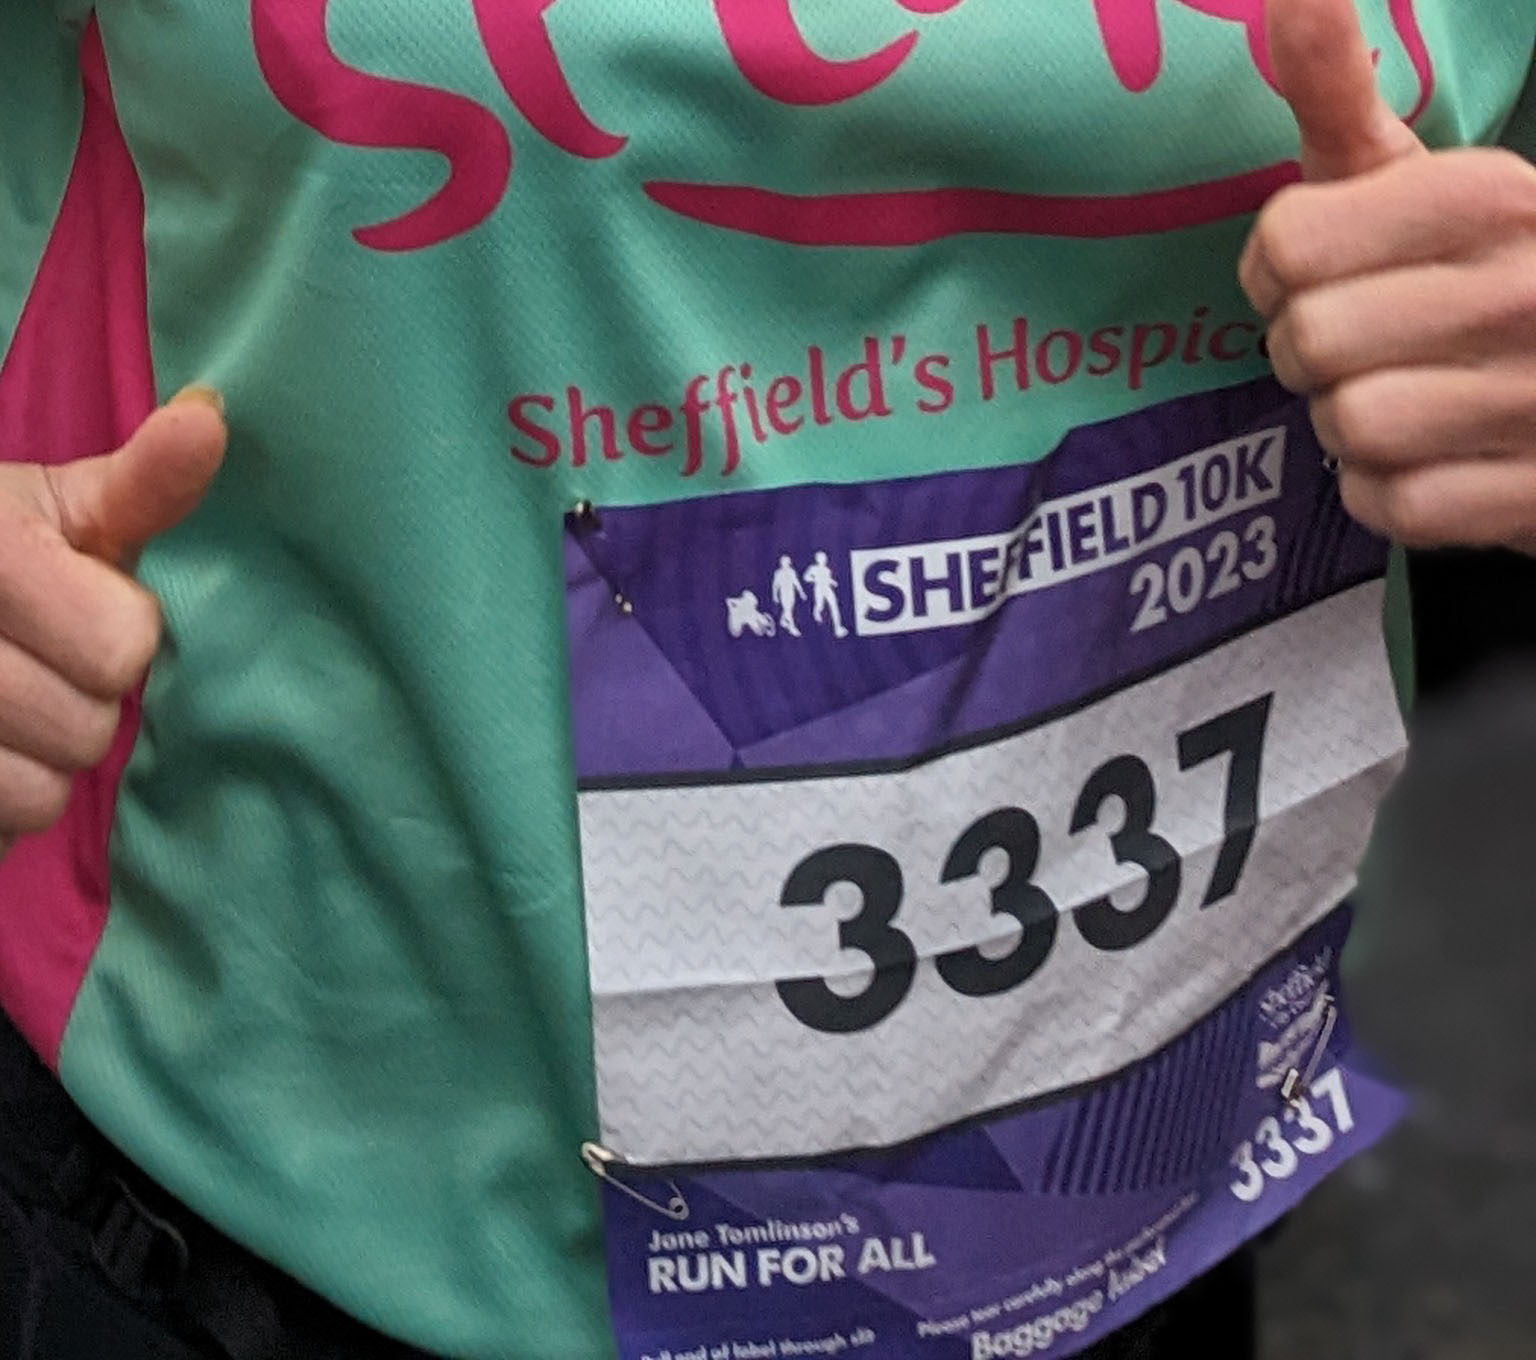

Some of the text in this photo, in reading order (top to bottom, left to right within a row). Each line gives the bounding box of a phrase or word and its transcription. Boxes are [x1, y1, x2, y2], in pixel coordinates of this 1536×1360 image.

[507, 306, 1269, 478] Sheffield's Hospic
[864, 436, 1275, 623] SHEFFIELD 10K
[1129, 515, 1278, 633] 2023
[774, 692, 1276, 1036] 3337
[1230, 1067, 1356, 1202] 3337
[648, 1228, 710, 1253] Jane
[648, 1231, 937, 1294] RUN FOR ALL
